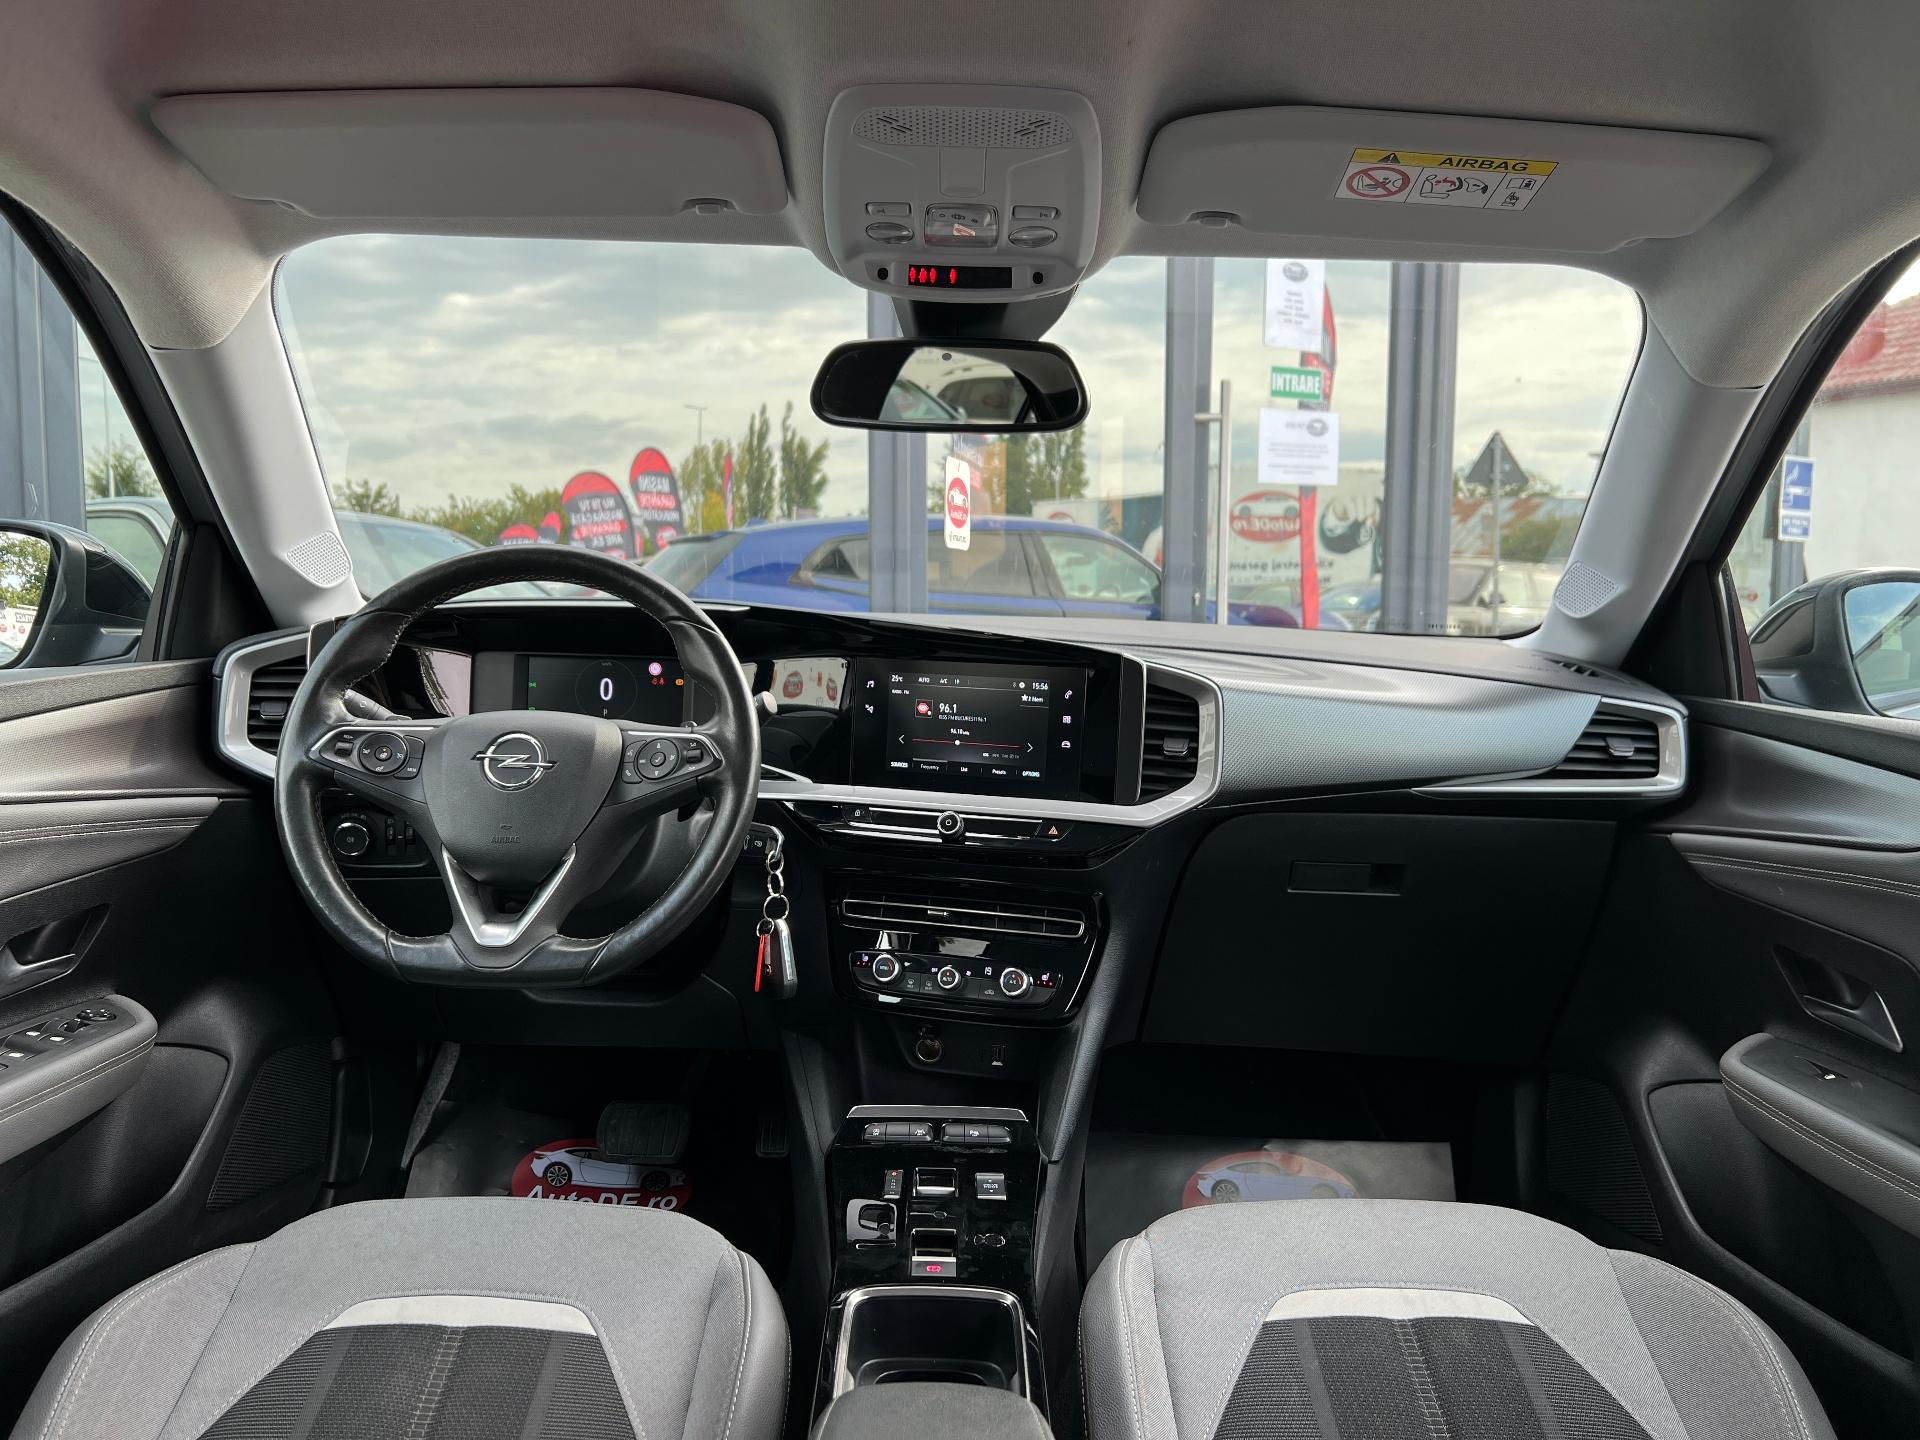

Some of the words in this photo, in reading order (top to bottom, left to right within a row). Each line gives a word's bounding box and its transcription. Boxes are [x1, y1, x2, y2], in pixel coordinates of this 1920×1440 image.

[1438, 157, 1529, 172] AIRBAG
[1272, 373, 1320, 395] INTRARE
[600, 677, 613, 701] 0
[1032, 682, 1048, 690] 15:56
[939, 703, 957, 713] 96.1
[527, 1184, 678, 1211] AutDEro
